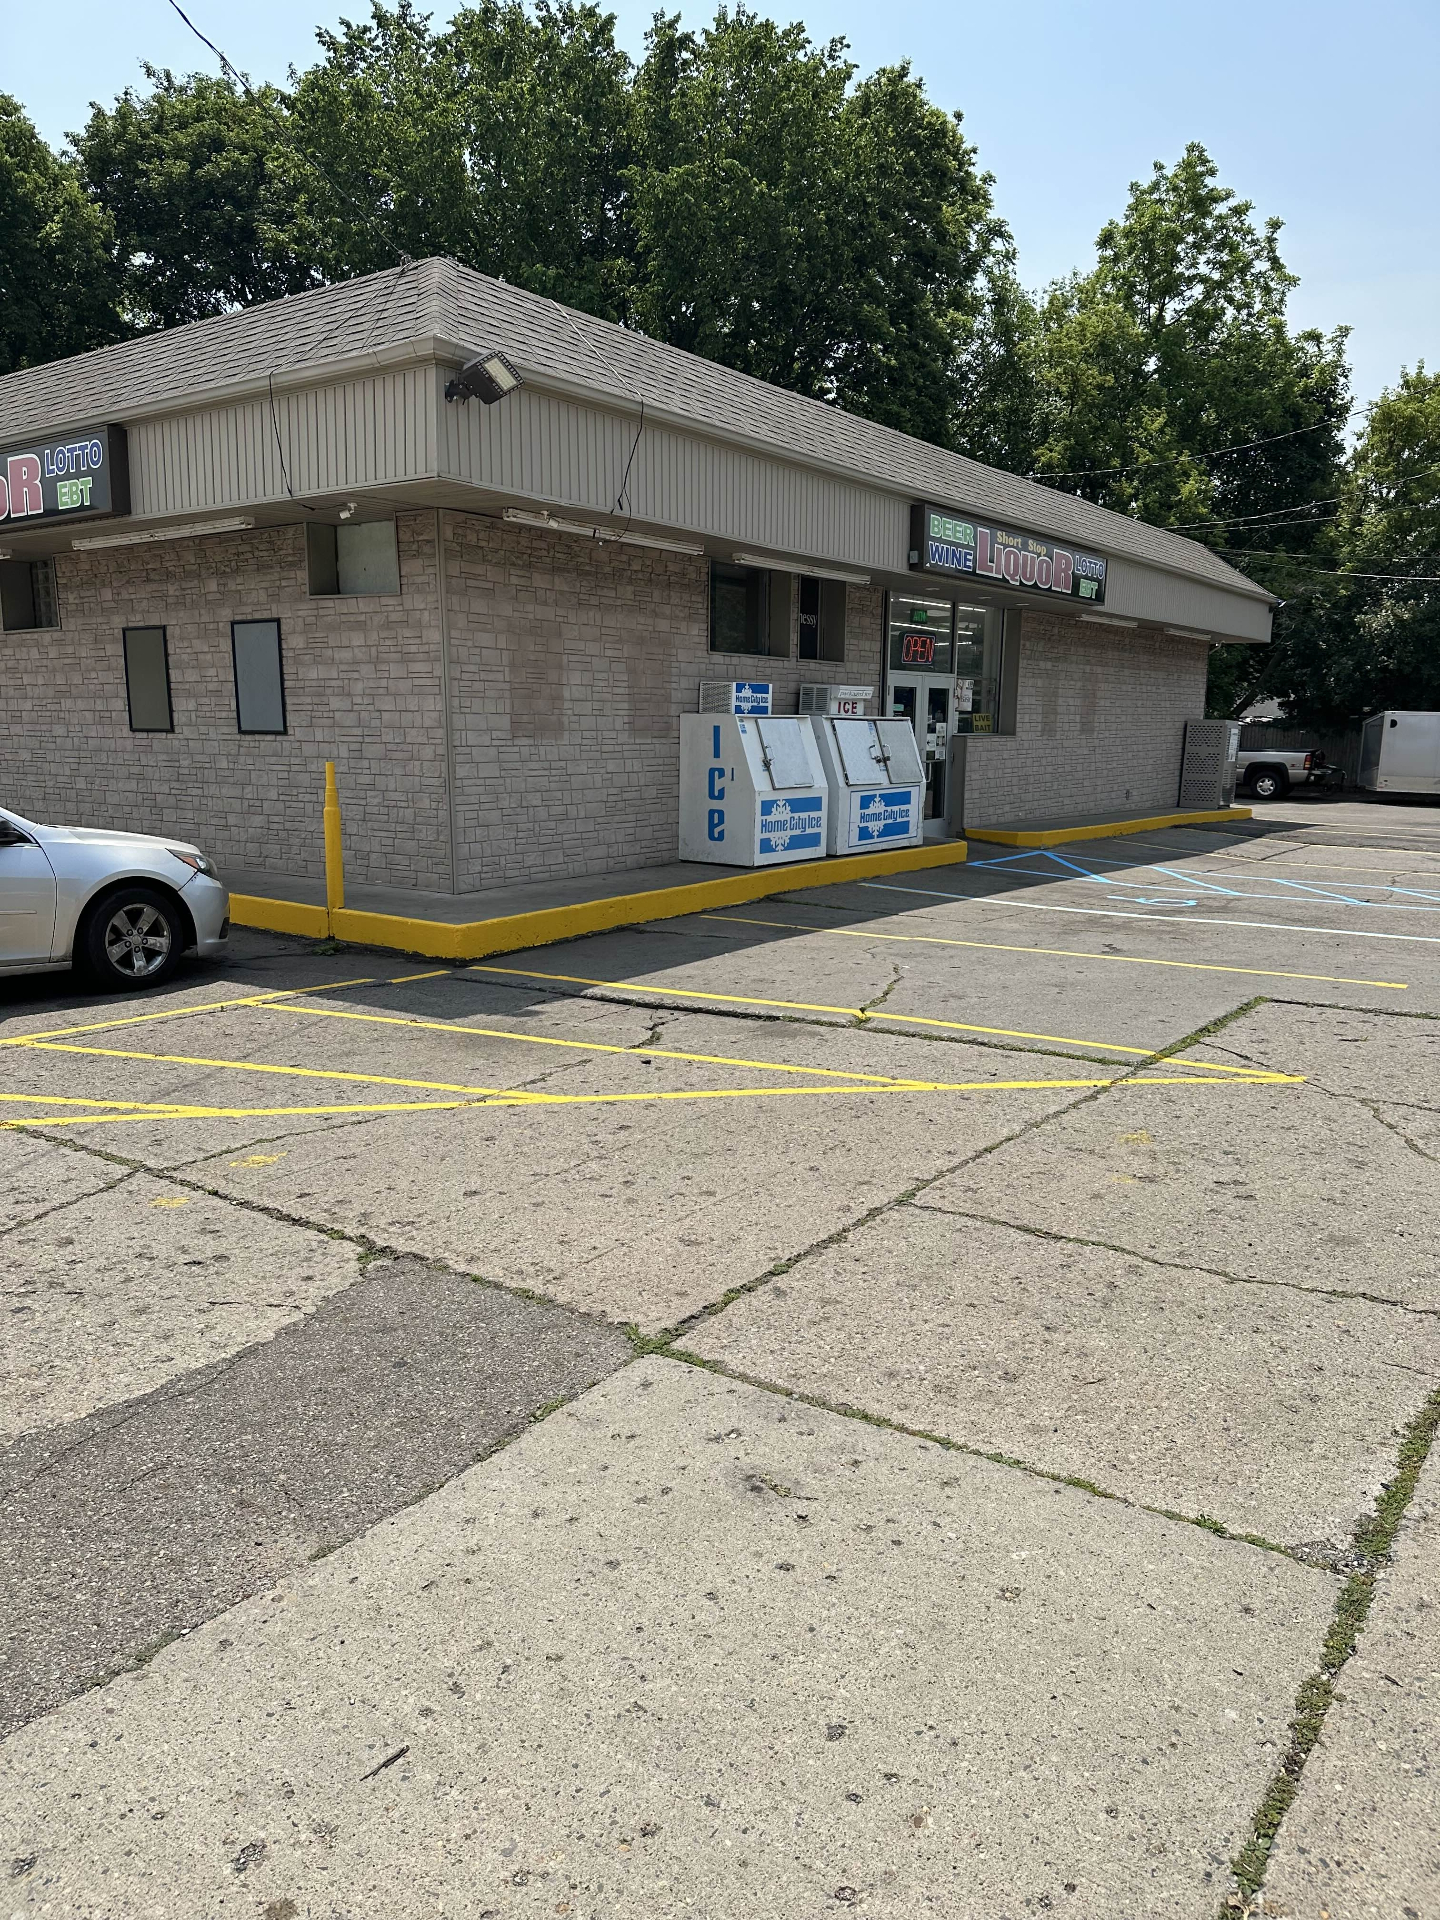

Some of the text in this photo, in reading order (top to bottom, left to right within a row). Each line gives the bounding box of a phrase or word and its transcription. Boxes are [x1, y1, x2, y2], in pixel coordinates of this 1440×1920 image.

[45, 440, 102, 477] LOTTO
[0, 453, 43, 520] R
[57, 477, 92, 509] EBT
[930, 514, 975, 546] BEER
[929, 541, 973, 572] WINE
[997, 531, 1047, 557] Short Stop
[976, 527, 1073, 594] LIQUOR
[1075, 555, 1105, 580] LOTTO
[1079, 578, 1099, 599] EBT
[904, 637, 934, 661] OPEN
[736, 694, 750, 703] Home
[751, 695, 760, 705] City
[838, 701, 857, 714] ICE
[975, 724, 991, 732] BAIT
[760, 815, 822, 834] Home City Ice
[860, 808, 910, 823] Home City Ice
